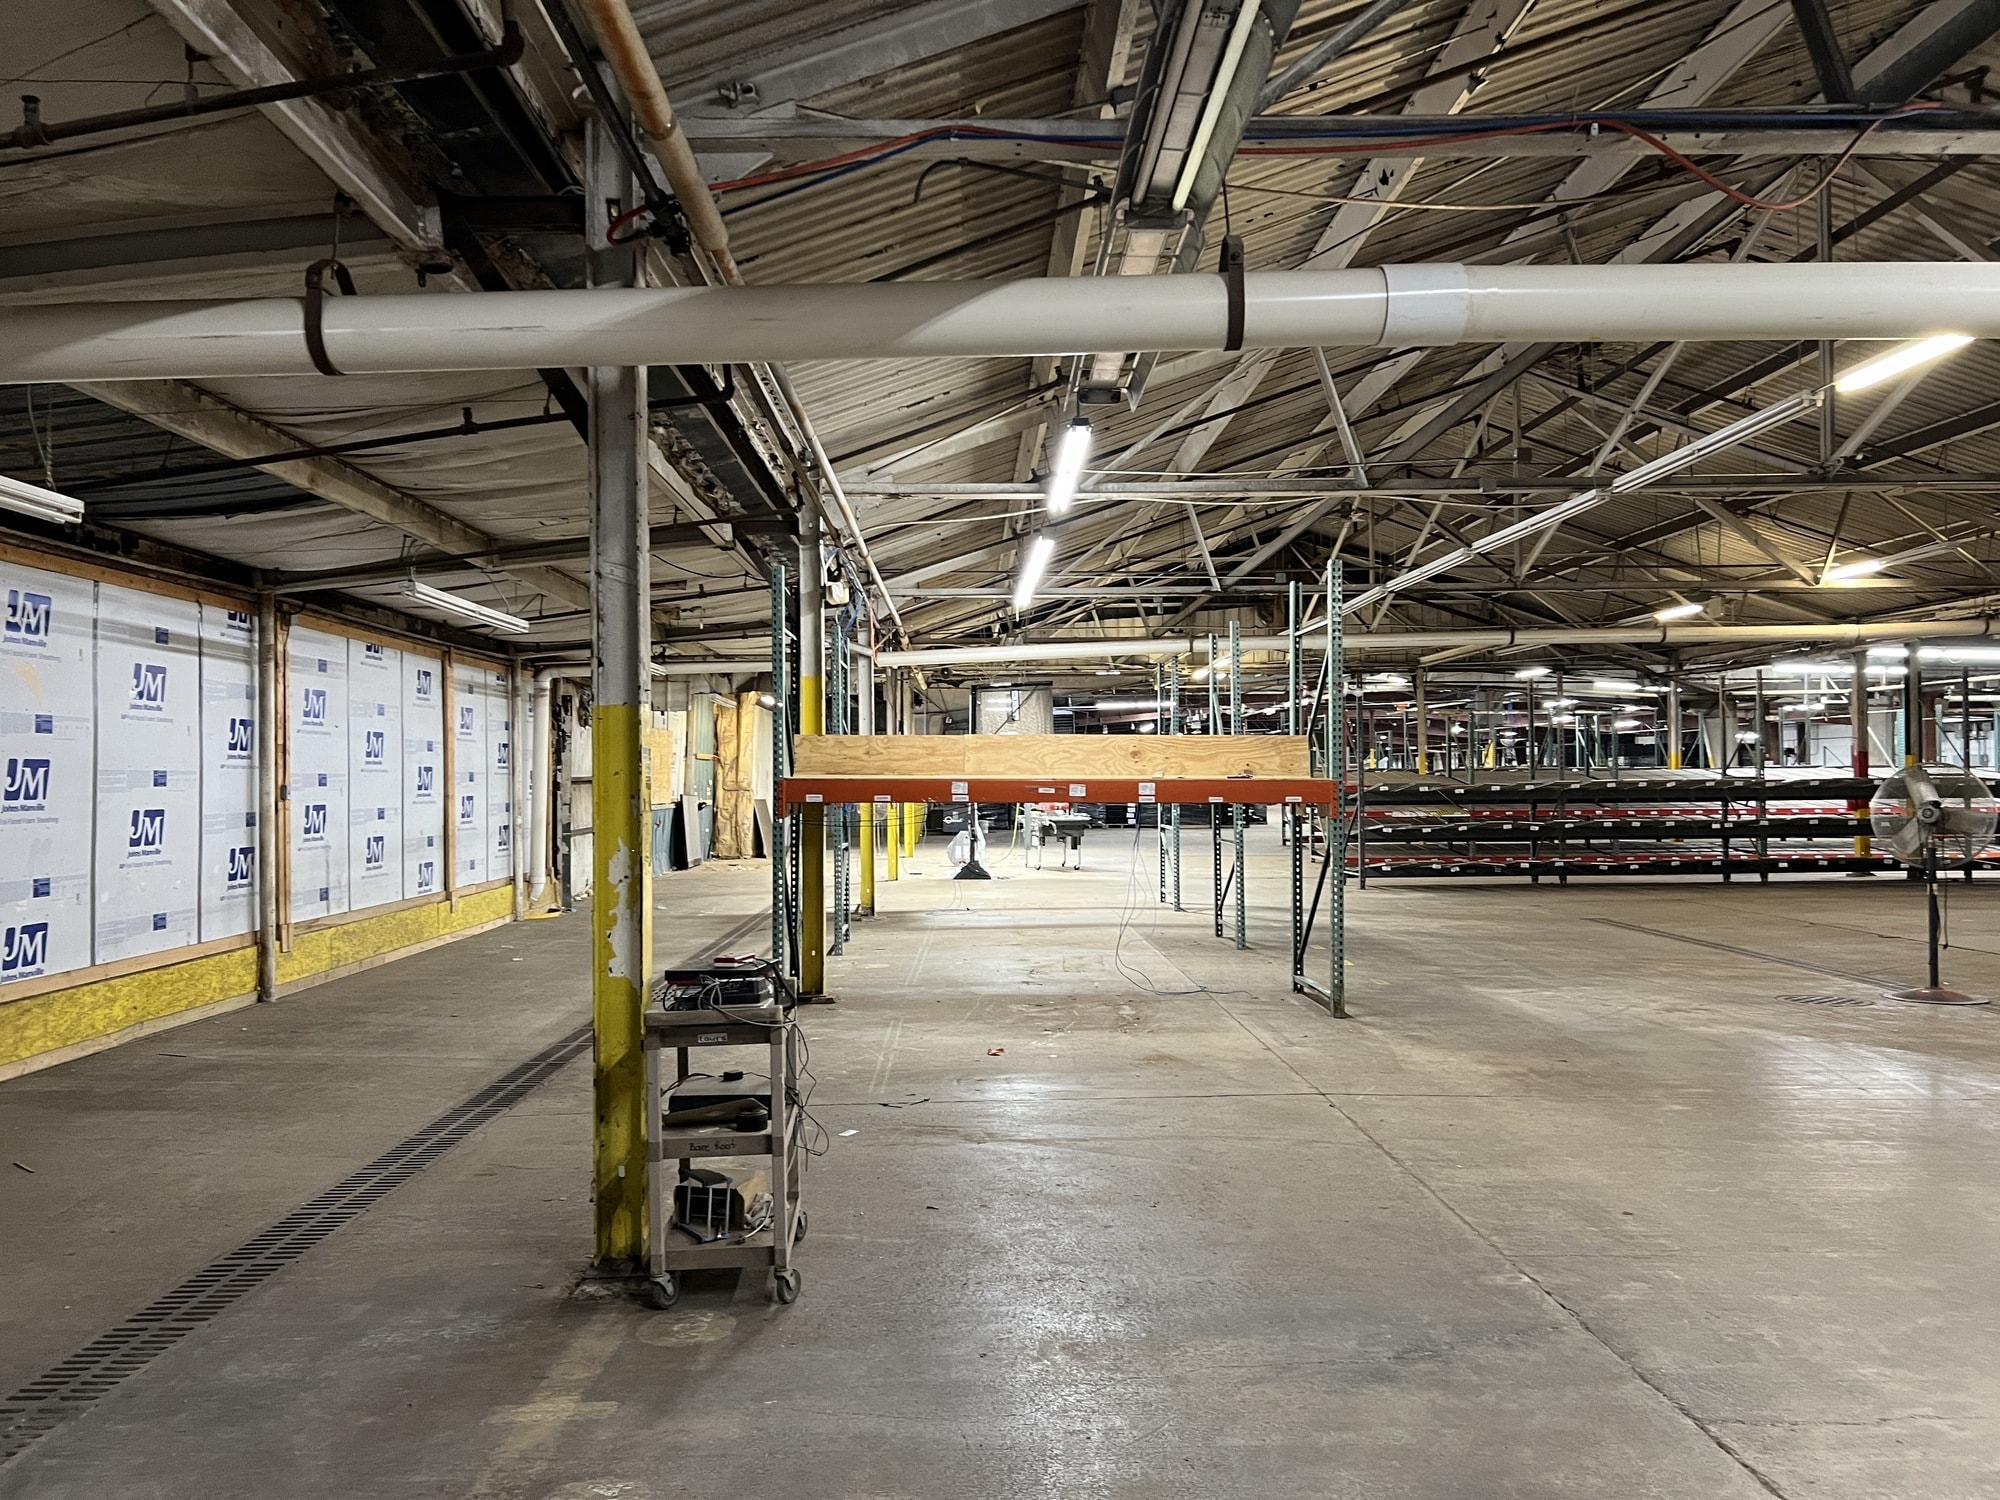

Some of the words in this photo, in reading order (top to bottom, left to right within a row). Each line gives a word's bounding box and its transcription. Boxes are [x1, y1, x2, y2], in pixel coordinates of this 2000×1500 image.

[4, 590, 53, 637] JM
[129, 663, 167, 702] JM
[416, 669, 432, 695] JM
[303, 688, 327, 719] JM
[228, 718, 255, 752] JM
[366, 730, 385, 758] JM
[4, 758, 52, 801] JM
[417, 766, 433, 790] JM
[128, 809, 166, 848] JM
[304, 804, 327, 834] JM
[228, 846, 255, 882] JM
[366, 836, 385, 864] JM
[418, 862, 434, 888] JM
[2, 922, 49, 971] JM
